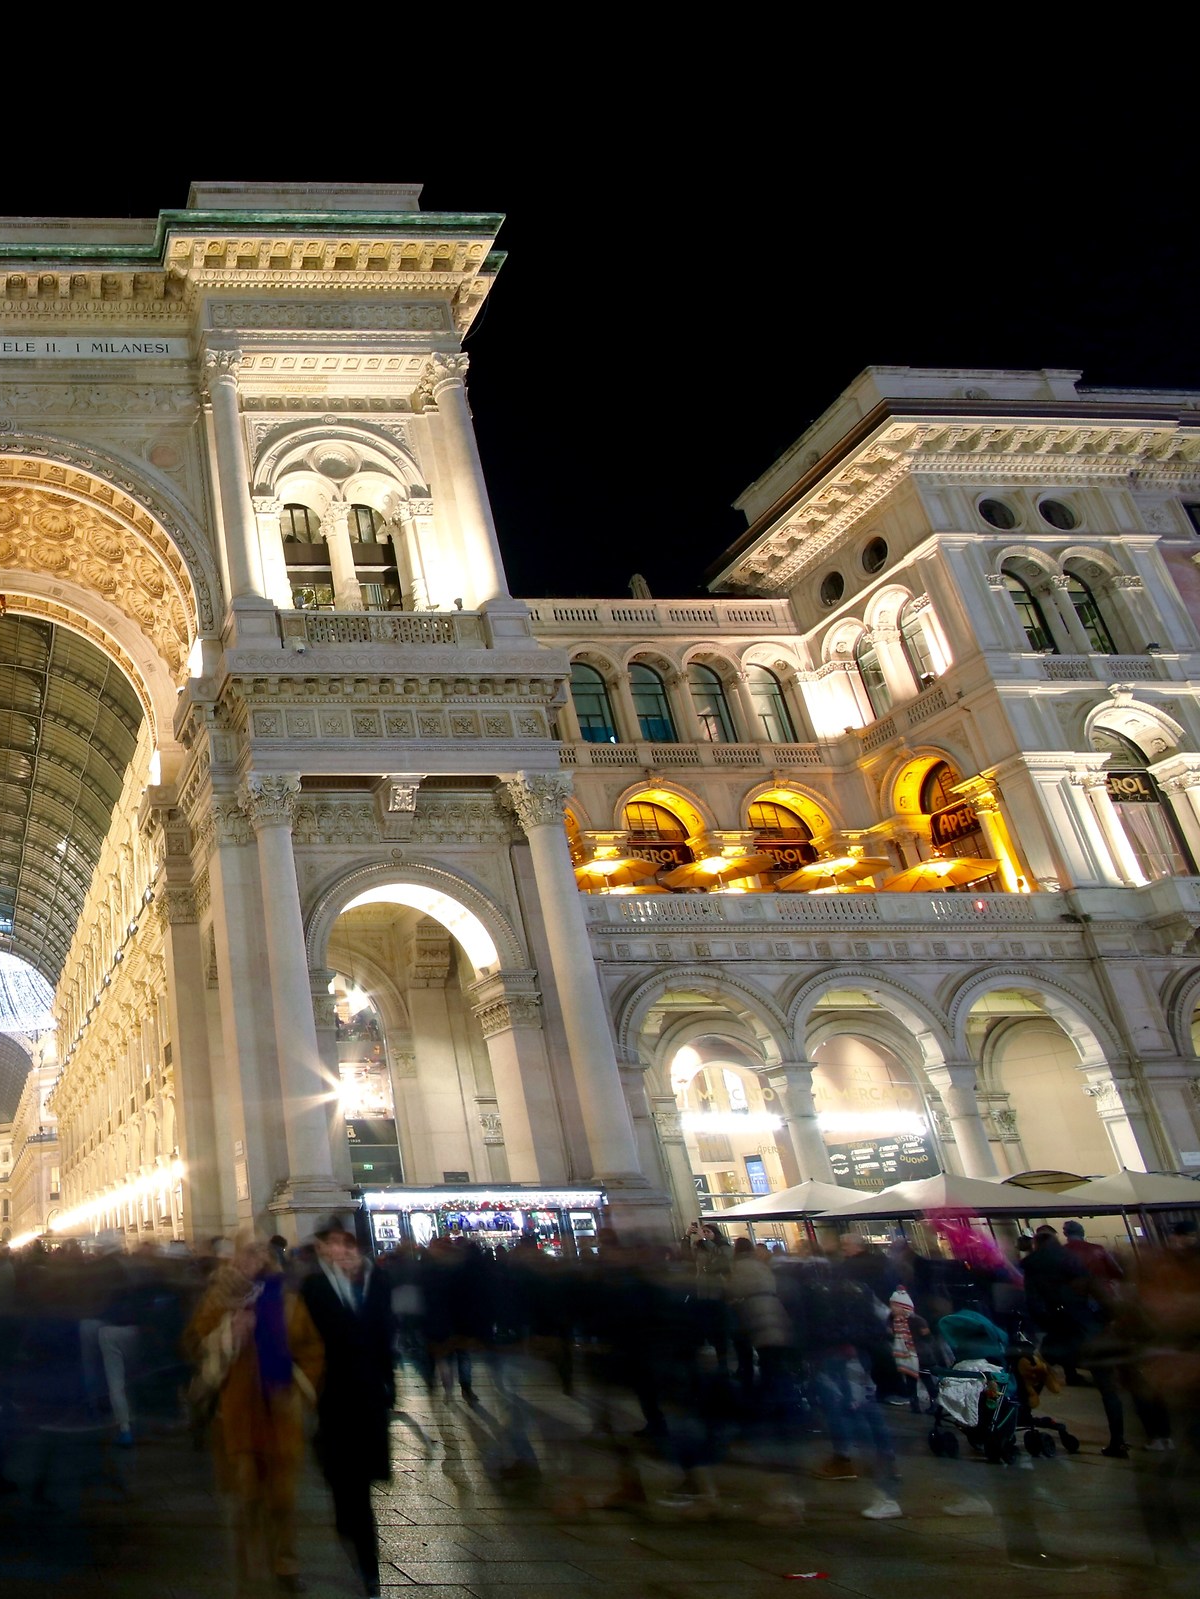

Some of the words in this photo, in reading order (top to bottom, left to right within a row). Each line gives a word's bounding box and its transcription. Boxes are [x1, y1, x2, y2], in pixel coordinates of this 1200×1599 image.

[46, 342, 61, 353] II.
[76, 342, 80, 353] I
[91, 342, 170, 354] MILANESI
[836, 1087, 913, 1101] MERCATO
[899, 1154, 929, 1164] DUOMO
